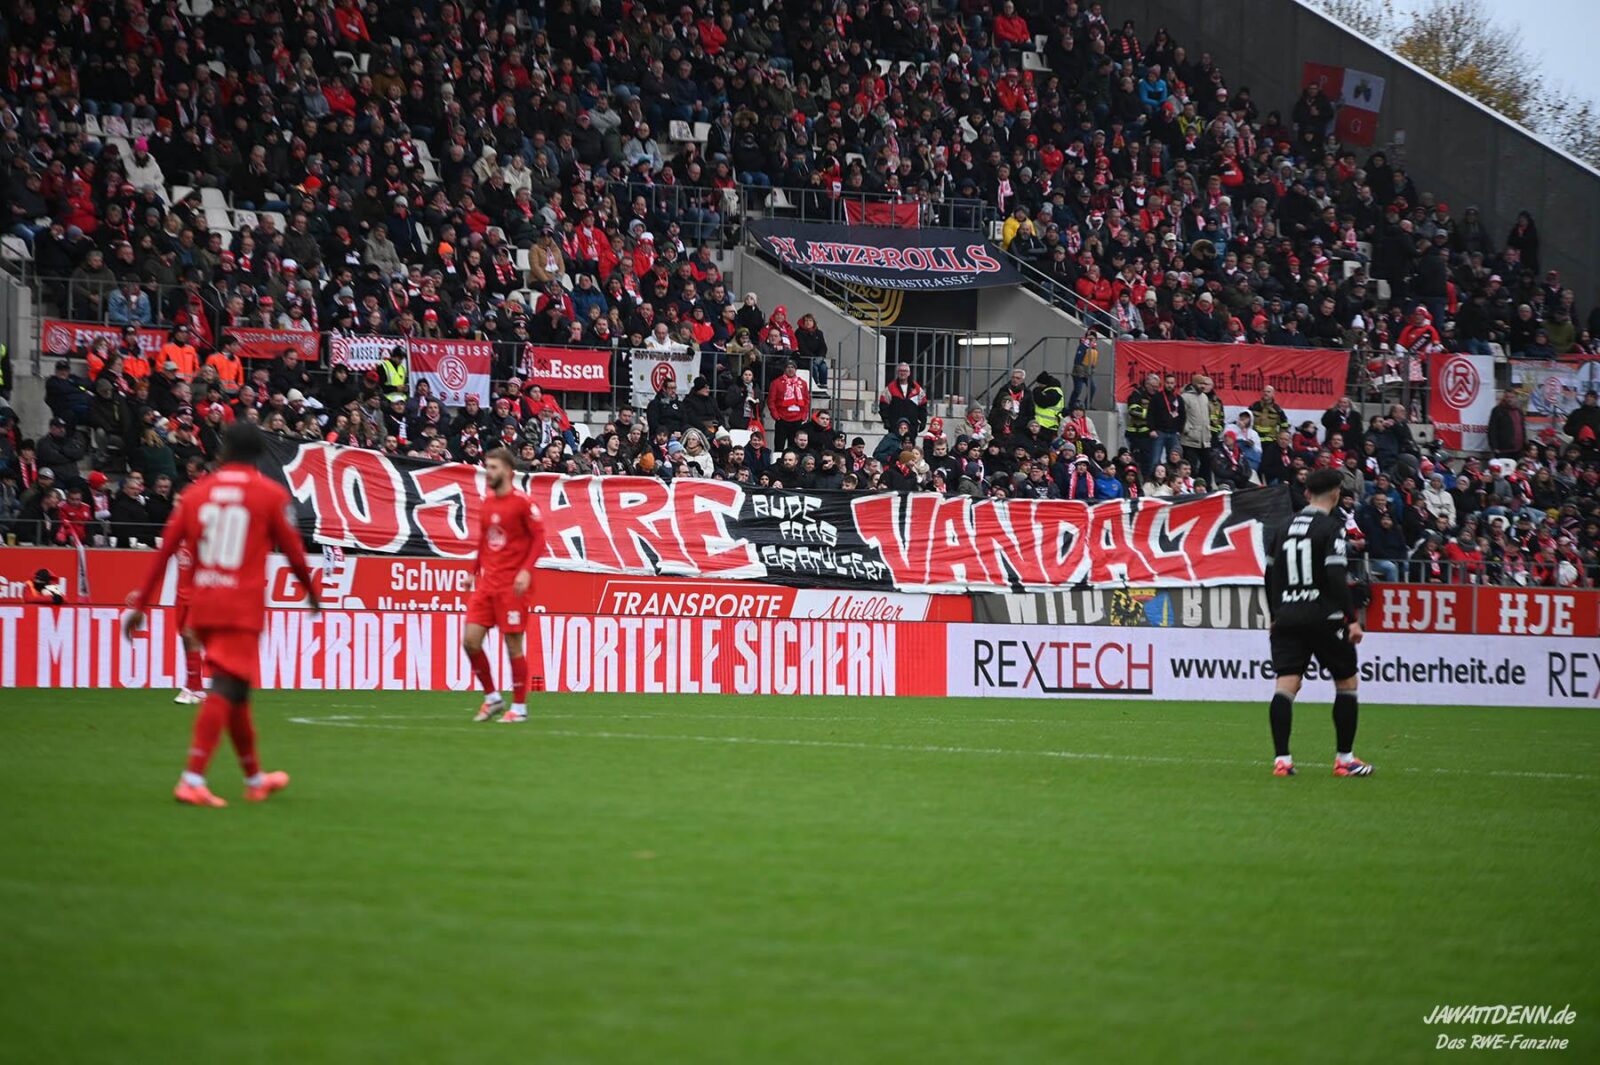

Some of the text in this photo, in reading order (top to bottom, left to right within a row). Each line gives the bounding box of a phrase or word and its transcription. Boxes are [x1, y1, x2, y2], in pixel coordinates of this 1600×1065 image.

[764, 235, 1001, 274] PLATZPROLLS
[411, 344, 490, 356] ROT-WEISS
[283, 441, 768, 579] 10 JHRE
[752, 494, 822, 523] RUDE
[198, 503, 250, 568] 30
[391, 561, 476, 592] Schwe
[1282, 537, 1314, 586] 11
[612, 591, 783, 618] TRANSPORTE
[808, 593, 904, 621] Müller
[1382, 589, 1457, 631] HJE
[1498, 592, 1576, 635] HJE
[37, 607, 213, 688] MITGLI
[260, 609, 431, 689] WERDEN
[540, 615, 721, 693] VORTEILE
[734, 618, 896, 696] SICHERN
[974, 639, 1153, 695] REXTECH
